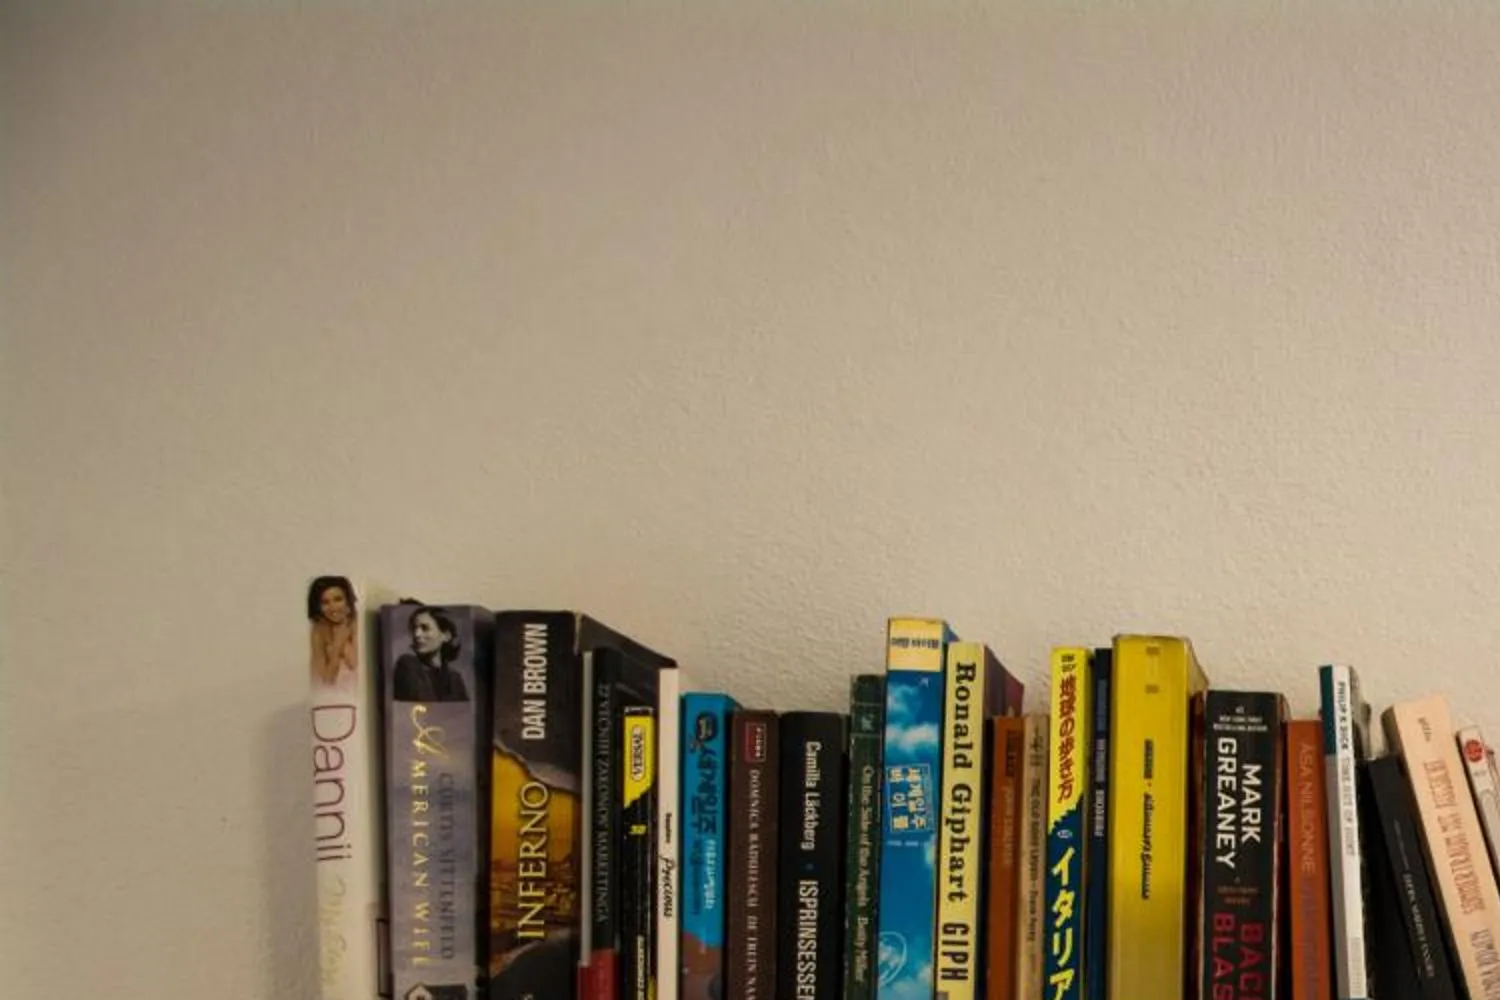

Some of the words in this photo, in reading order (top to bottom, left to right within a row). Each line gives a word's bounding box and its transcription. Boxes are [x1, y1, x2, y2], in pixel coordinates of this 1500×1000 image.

[521, 622, 549, 694] BROWN
[520, 699, 547, 741] DAN
[951, 661, 977, 770] Ronald
[1336, 681, 1348, 713] PHILIP
[804, 740, 822, 788] Camilla
[1339, 725, 1350, 750] DICK
[311, 704, 358, 864] Dannii
[410, 704, 450, 889] AMERICAN
[438, 773, 457, 842] CURTIS
[861, 765, 874, 784] On
[861, 785, 873, 803] the
[1215, 736, 1239, 870] GREANEY
[1240, 762, 1263, 845] MARK
[800, 791, 822, 850] Läckberg
[945, 783, 972, 904] Giphart
[516, 780, 550, 940] INFERNO
[440, 847, 457, 961] SITTENFELD
[940, 922, 971, 982] GIPH
